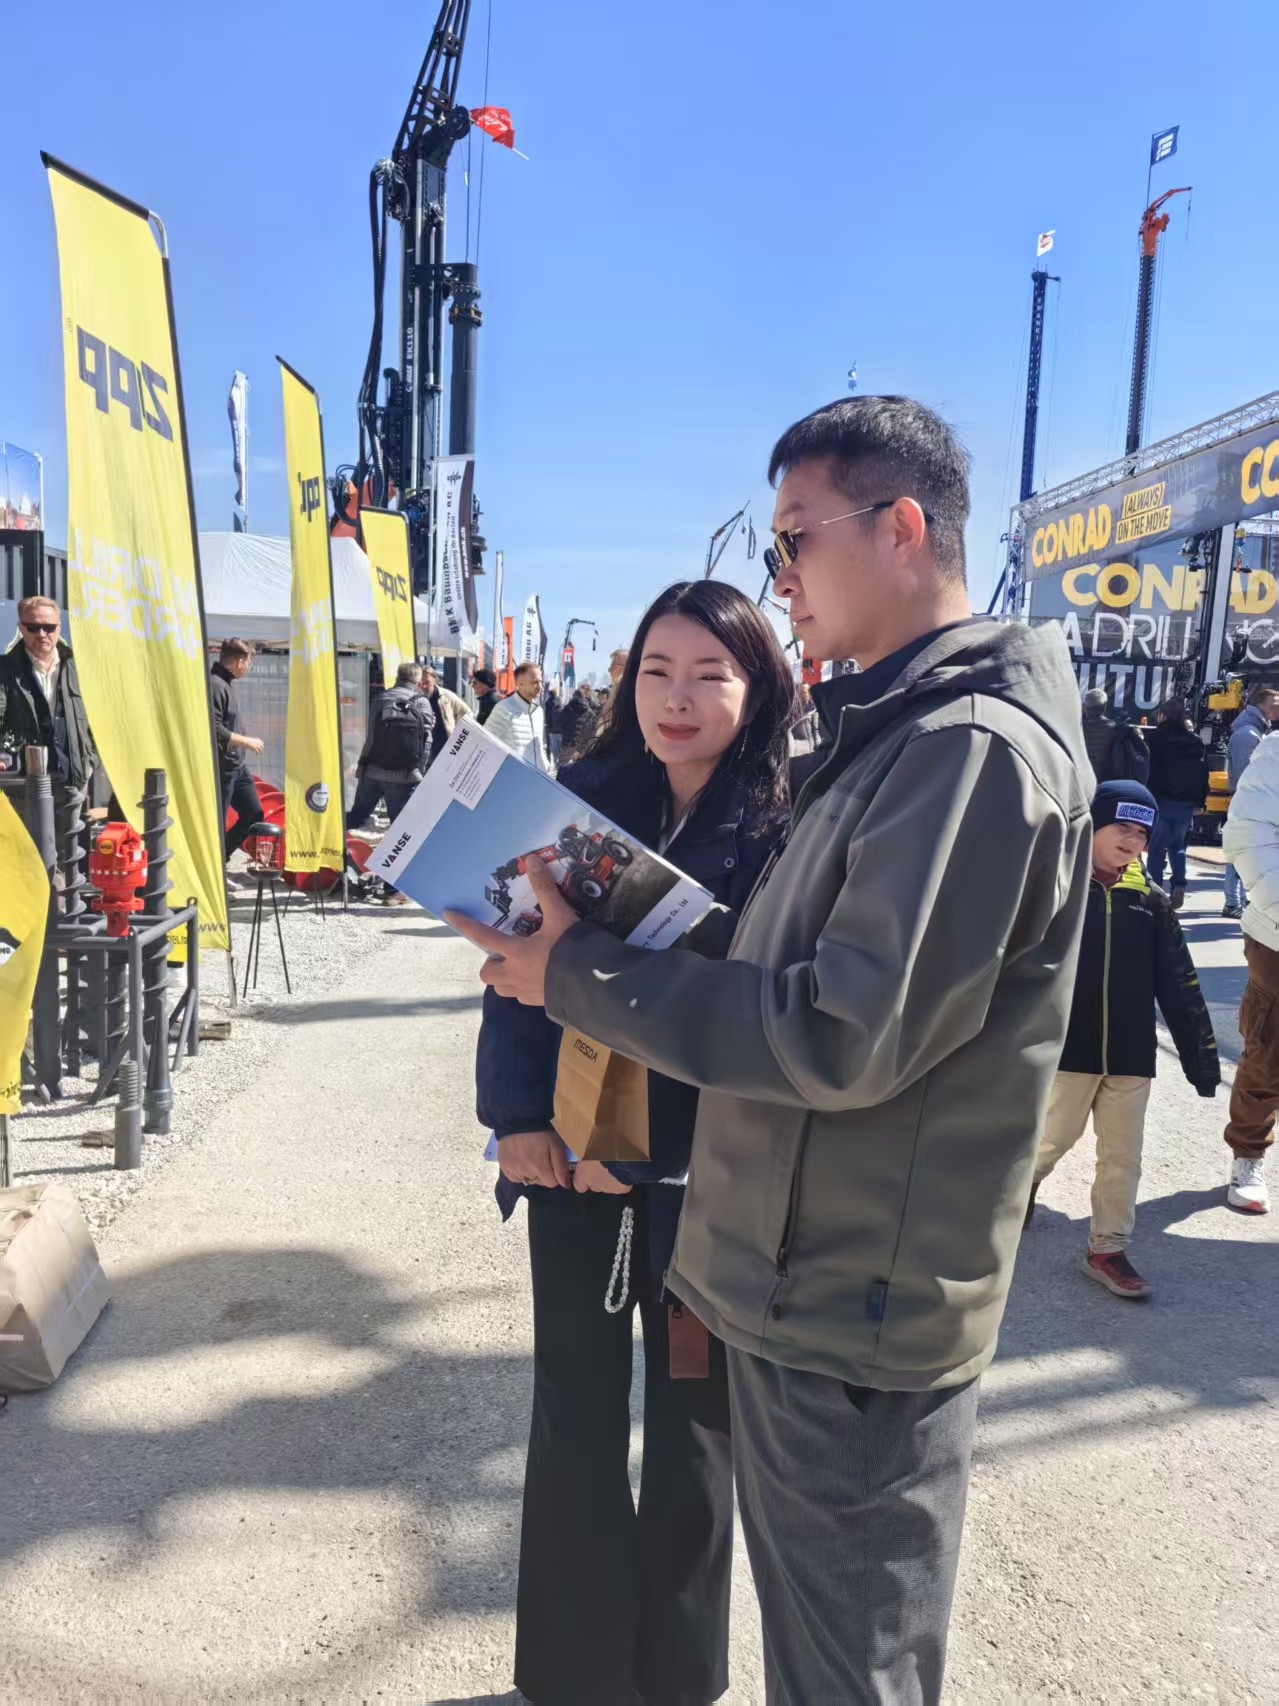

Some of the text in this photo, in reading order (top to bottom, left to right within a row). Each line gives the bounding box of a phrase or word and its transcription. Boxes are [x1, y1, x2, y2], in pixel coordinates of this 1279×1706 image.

[1031, 503, 1112, 568] CONRAD
[1117, 508, 1169, 541] ON THE MOVE
[449, 727, 470, 757] VANSE
[382, 831, 412, 870] VANSE
